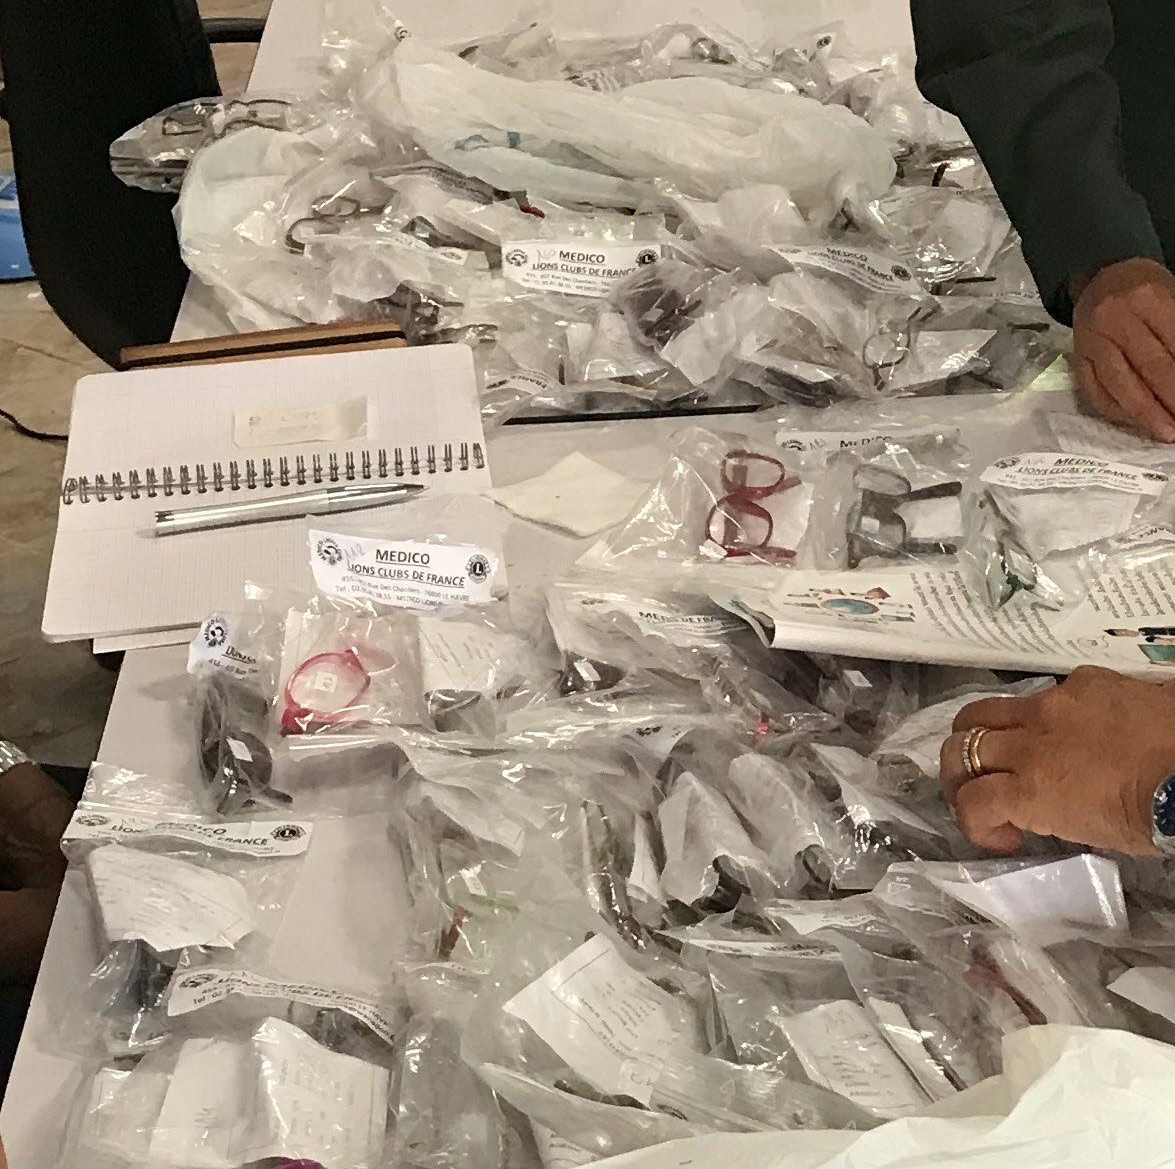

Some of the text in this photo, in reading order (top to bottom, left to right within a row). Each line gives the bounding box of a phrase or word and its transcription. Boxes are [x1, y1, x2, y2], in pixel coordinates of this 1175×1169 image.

[559, 250, 605, 264] MEDICO
[826, 247, 868, 262] MEDICO
[532, 262, 558, 271] LIONS
[560, 264, 587, 275] CLUBS
[588, 267, 600, 276] DE
[1017, 466, 1049, 476] LIONS
[1050, 467, 1080, 475] CLUBS
[376, 549, 431, 565] MEDICO
[378, 567, 410, 579] CLUBS
[412, 570, 424, 581] DE
[427, 573, 466, 587] FRANCE
